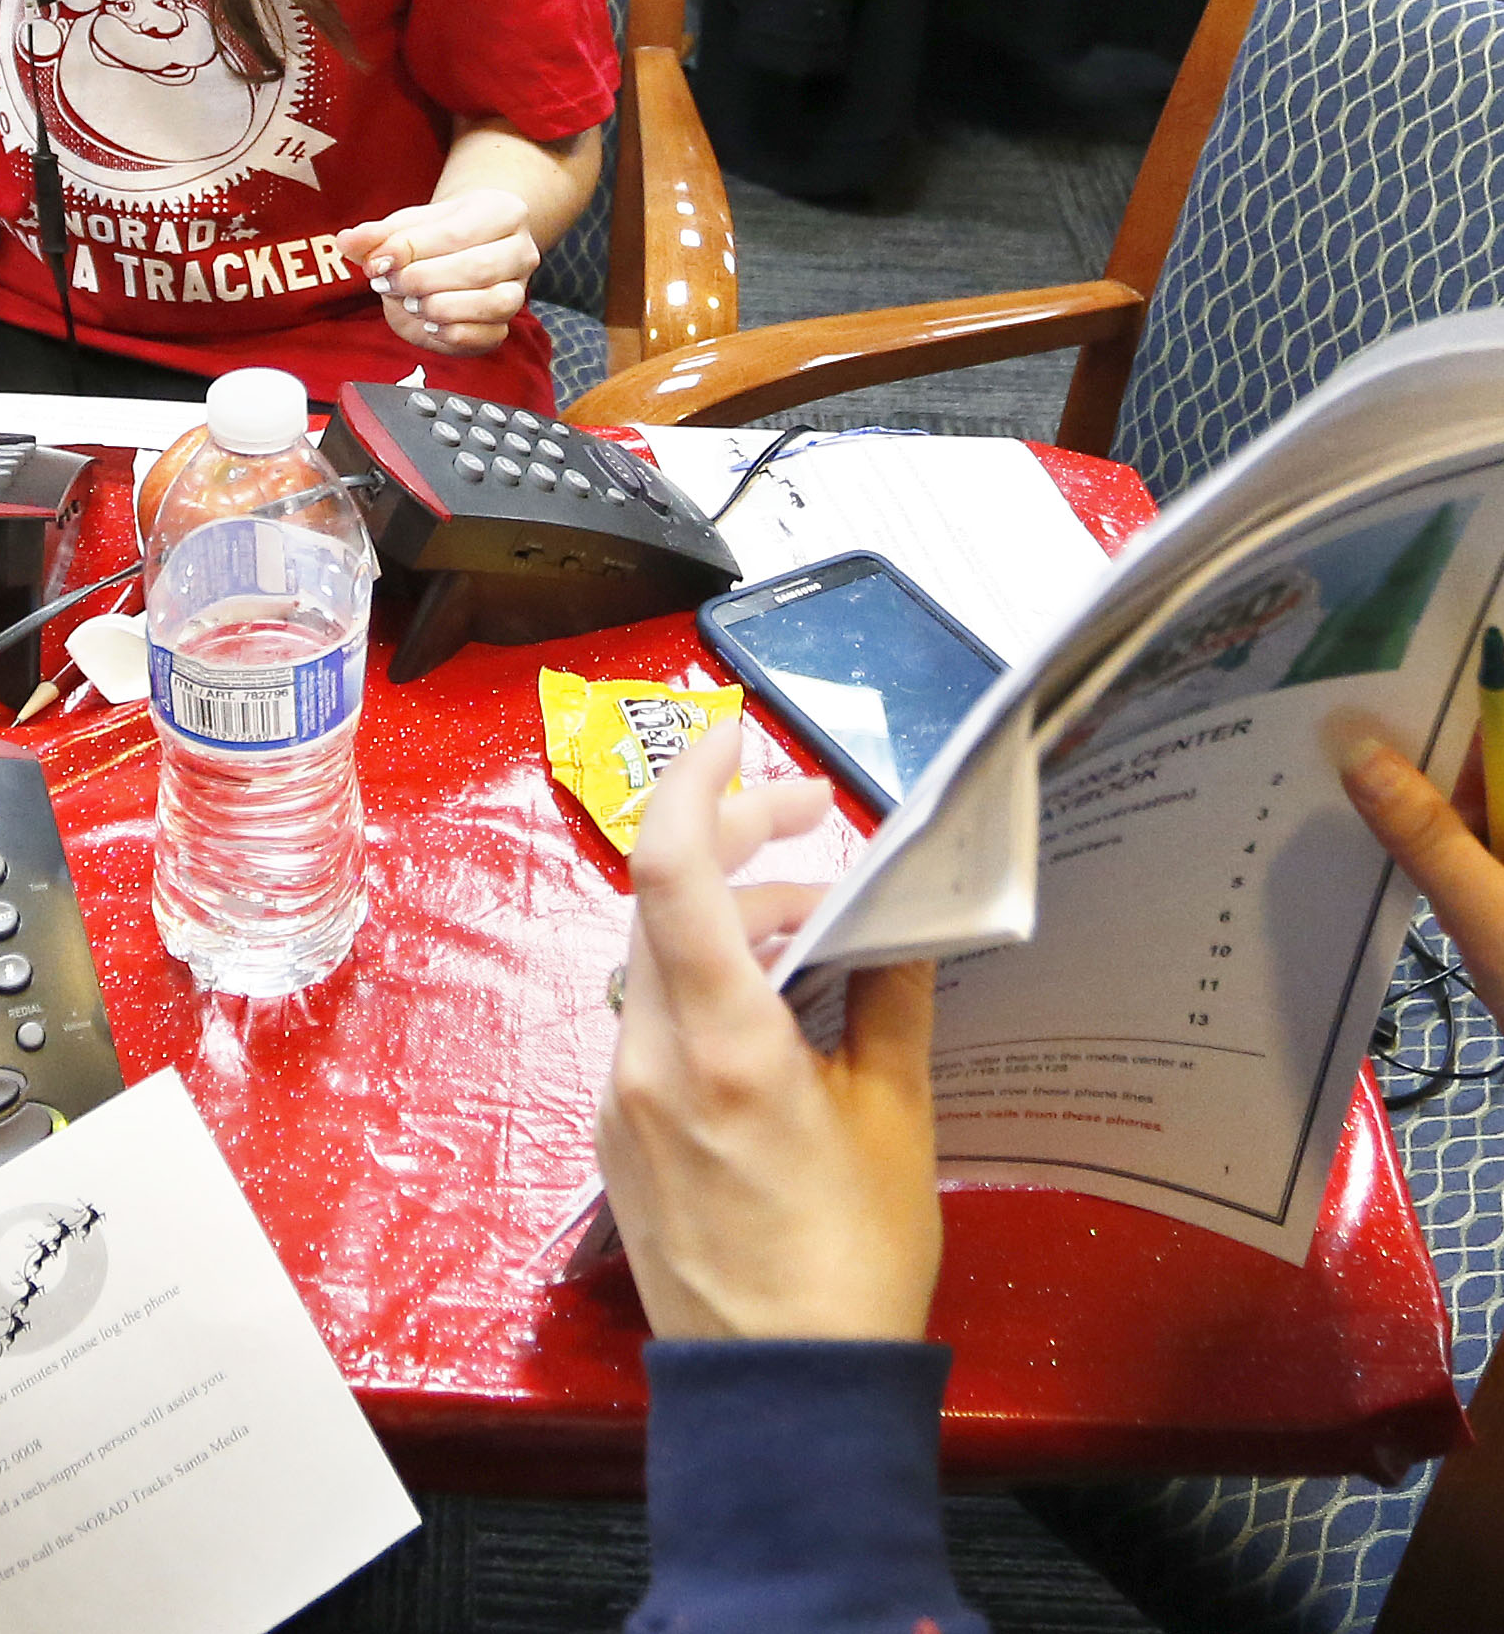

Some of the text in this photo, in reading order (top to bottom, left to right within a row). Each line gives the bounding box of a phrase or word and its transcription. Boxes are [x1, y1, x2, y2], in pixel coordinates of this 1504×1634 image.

[272, 135, 308, 163] 14
[65, 212, 216, 254] NORAD
[114, 233, 353, 303] TRACKER
[774, 582, 822, 604] SAMSUNG
[244, 688, 289, 701] 782796
[1130, 717, 1253, 767] CENTER
[8, 1003, 42, 1018] REDIAL
[9, 1363, 59, 1397] minutes
[59, 1336, 98, 1369] please
[97, 1322, 122, 1341] log
[120, 1309, 141, 1326] the
[143, 1285, 179, 1317] phone
[10, 1438, 42, 1462] 0008
[12, 1497, 20, 1508] a
[20, 1451, 94, 1500] tech-support
[96, 1425, 137, 1459] person
[139, 1406, 164, 1428] will
[166, 1385, 198, 1413] assist
[15, 1558, 30, 1571] to
[31, 1541, 54, 1562] call
[54, 1532, 74, 1549] the
[75, 1499, 129, 1532] NORAD
[131, 1473, 173, 1503] Tracks
[173, 1451, 209, 1476] Santa
[208, 1425, 249, 1451] Media
